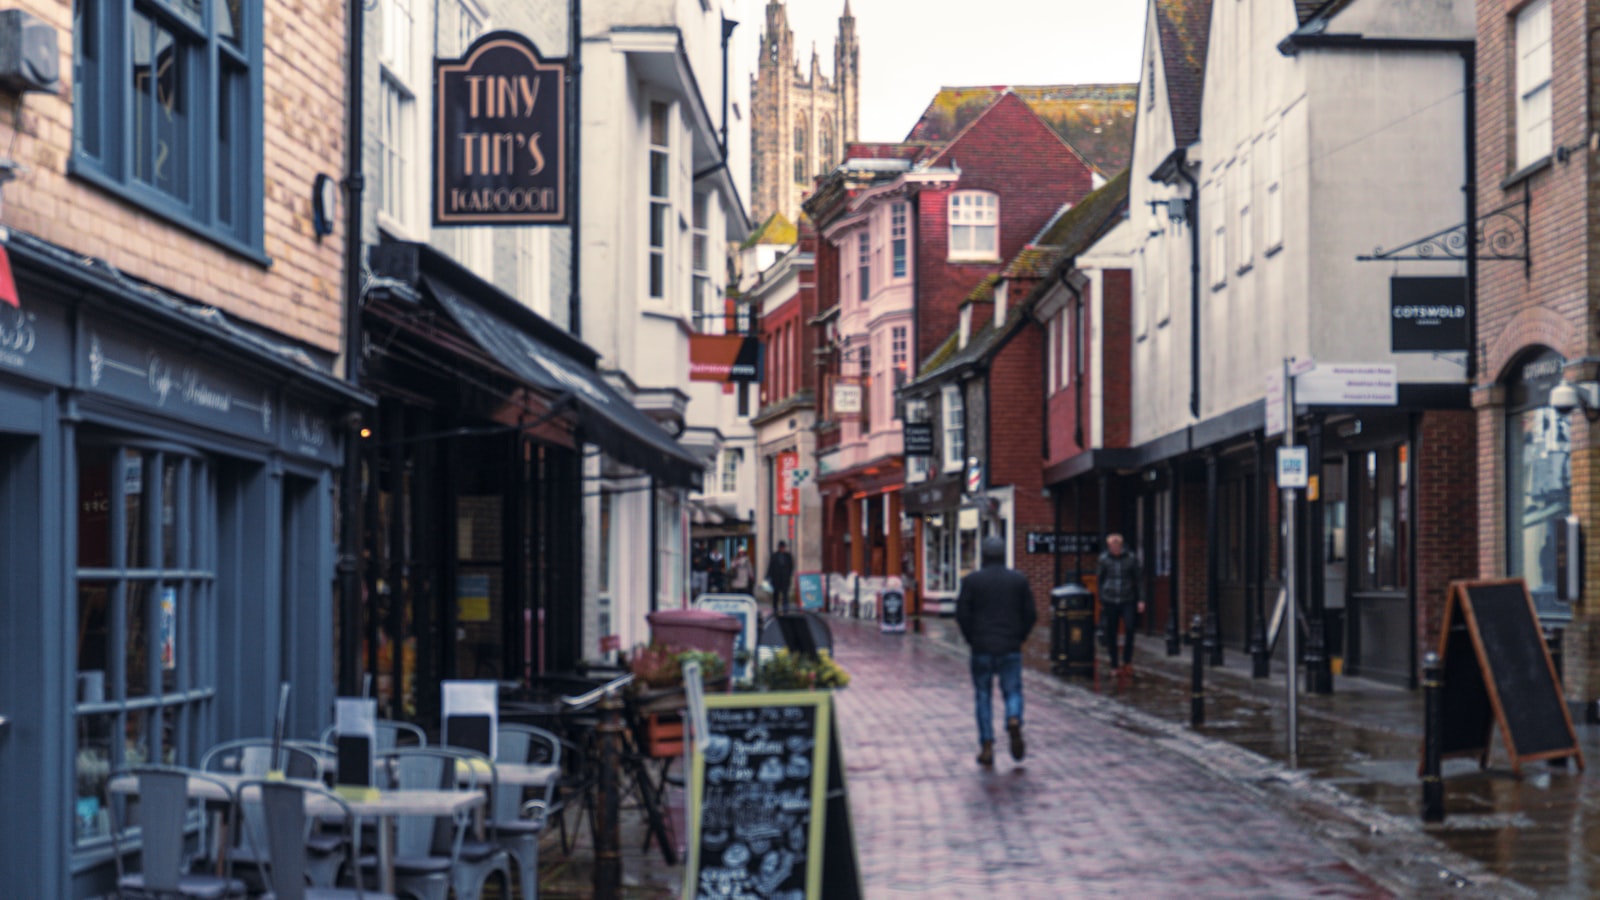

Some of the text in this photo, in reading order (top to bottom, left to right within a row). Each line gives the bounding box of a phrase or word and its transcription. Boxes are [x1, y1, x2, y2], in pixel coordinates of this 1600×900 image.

[464, 74, 540, 119] TINY
[458, 131, 545, 176] TIM'S
[1393, 305, 1466, 318] COTSWOLD
